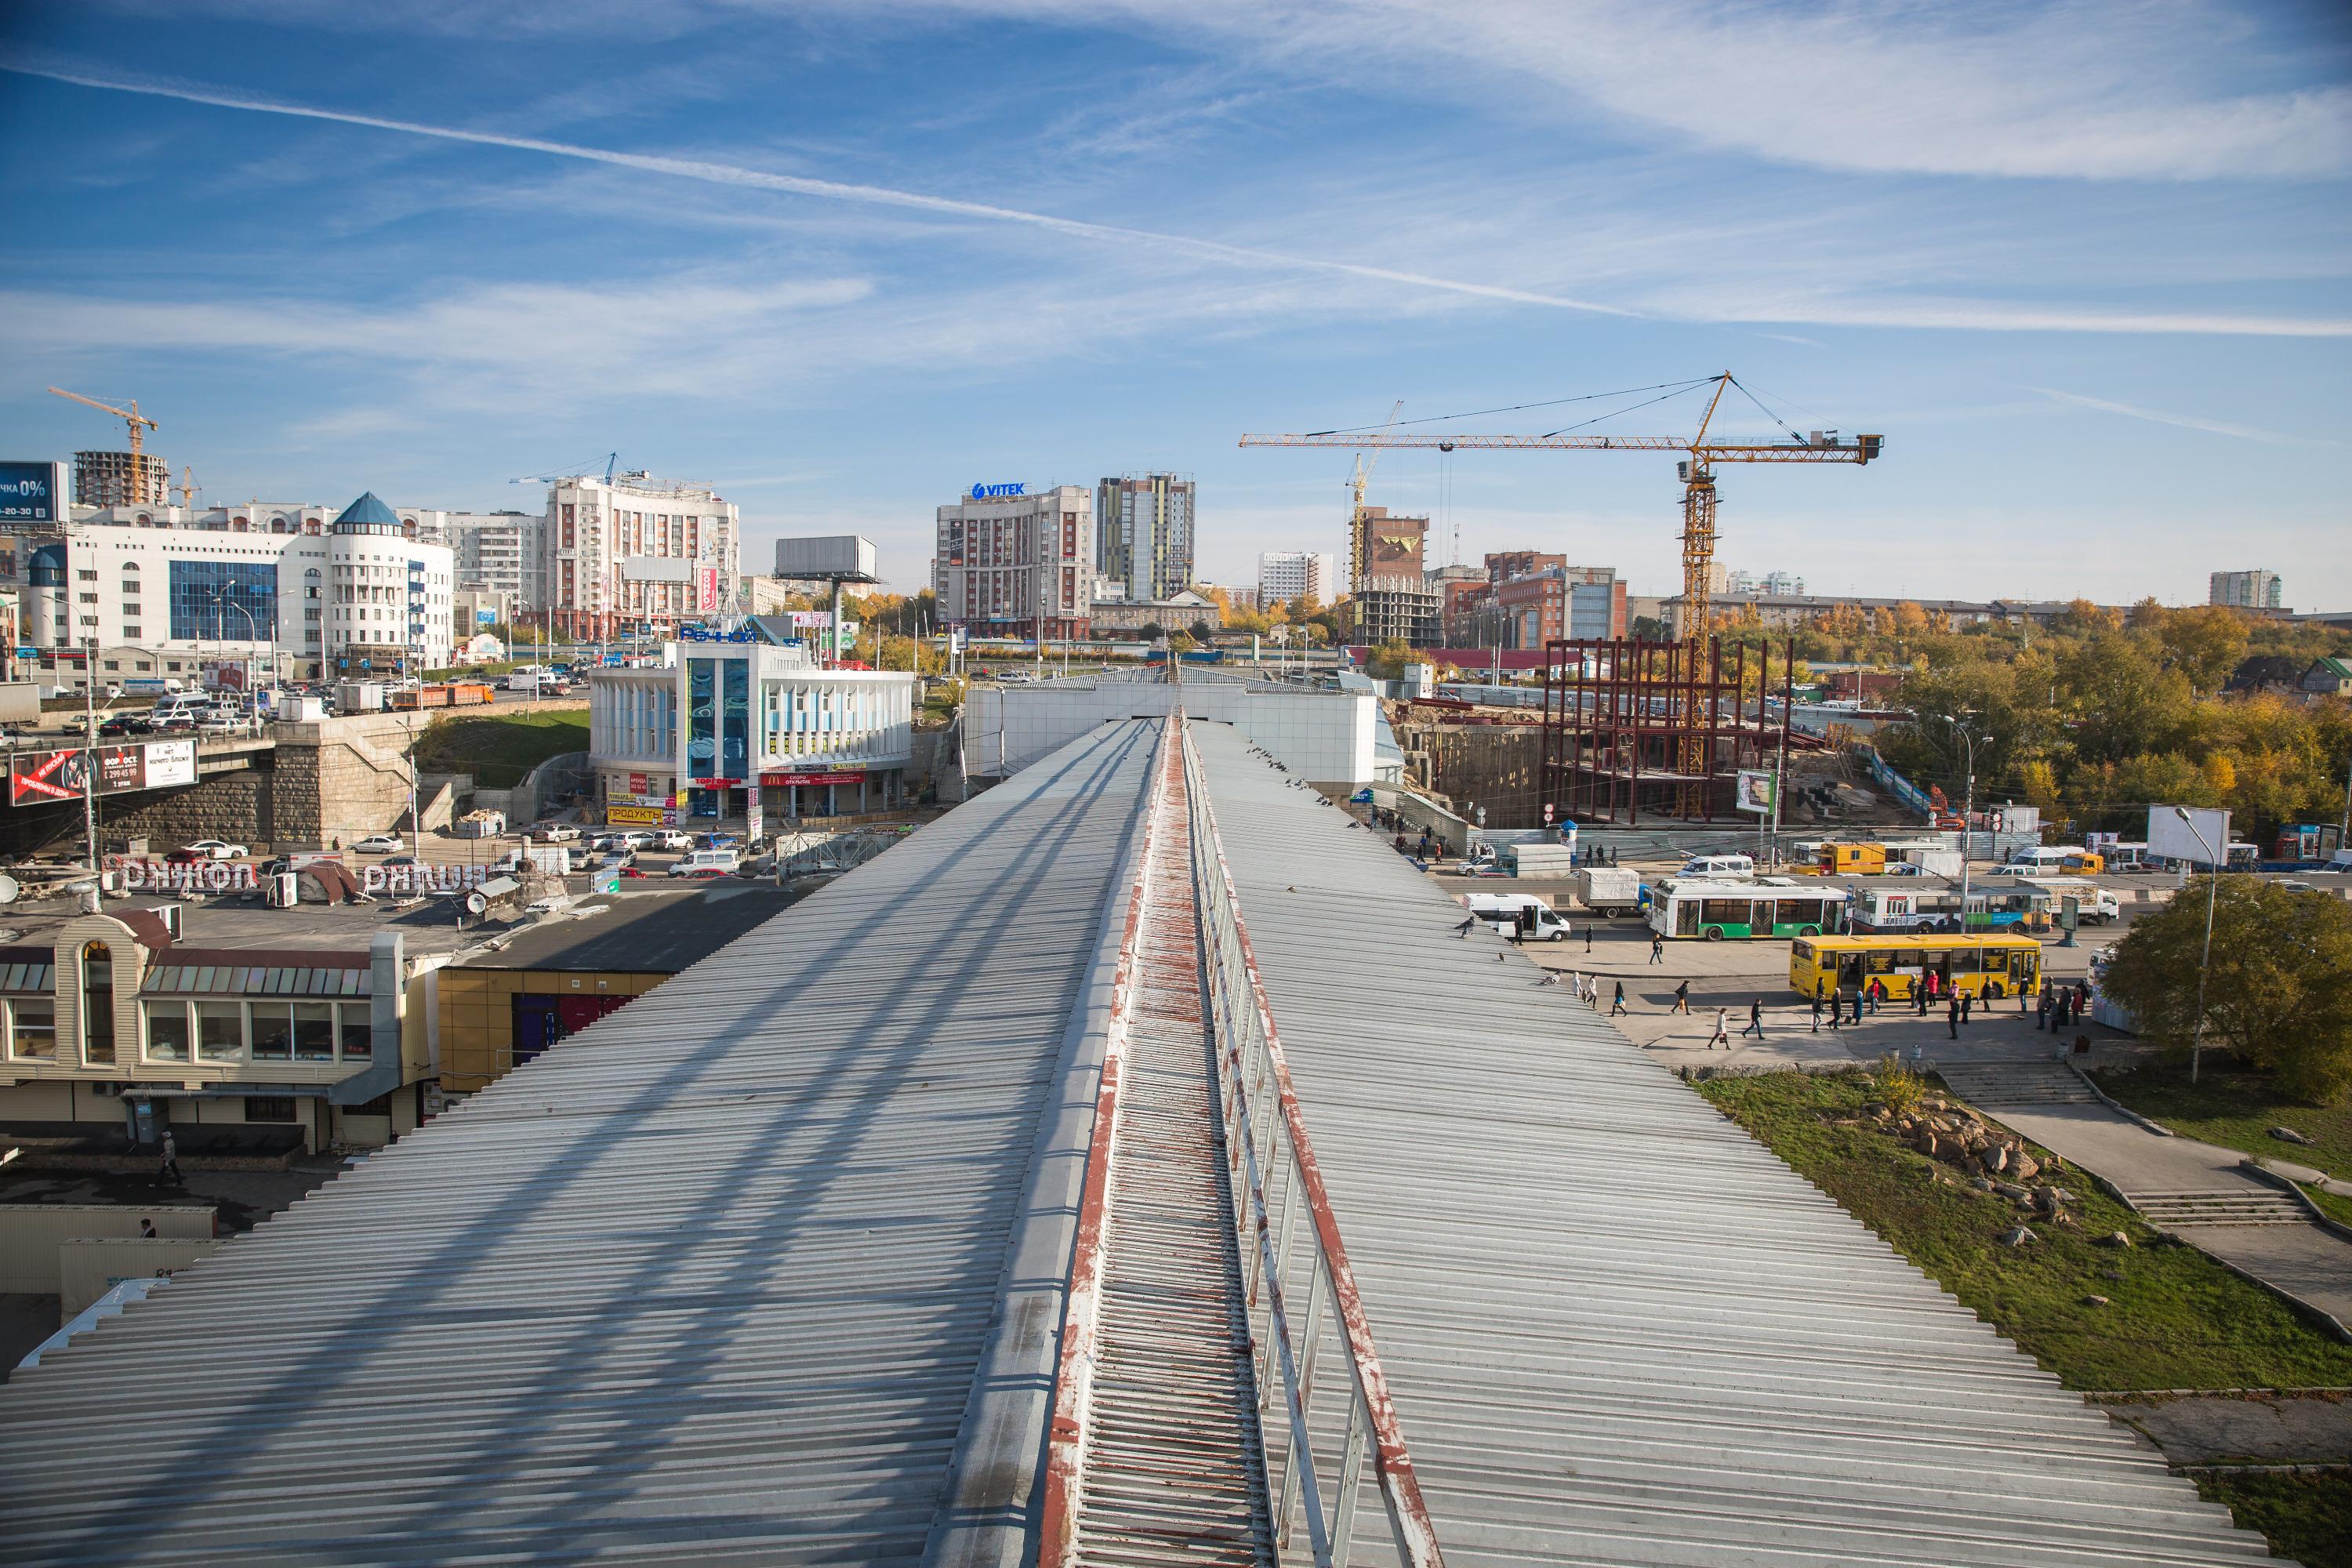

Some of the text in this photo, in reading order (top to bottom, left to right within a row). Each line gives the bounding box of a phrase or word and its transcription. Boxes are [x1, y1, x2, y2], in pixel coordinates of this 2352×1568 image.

[20, 481, 45, 496] 0%
[986, 483, 1024, 495] VITEK
[681, 627, 757, 643] Речной
[45, 753, 65, 771] ПУСКАЙ
[109, 768, 137, 779] 299 45 99
[21, 778, 51, 793] ПРОБЛЕМЫ
[609, 808, 662, 819] ПРОДУКТЫ
